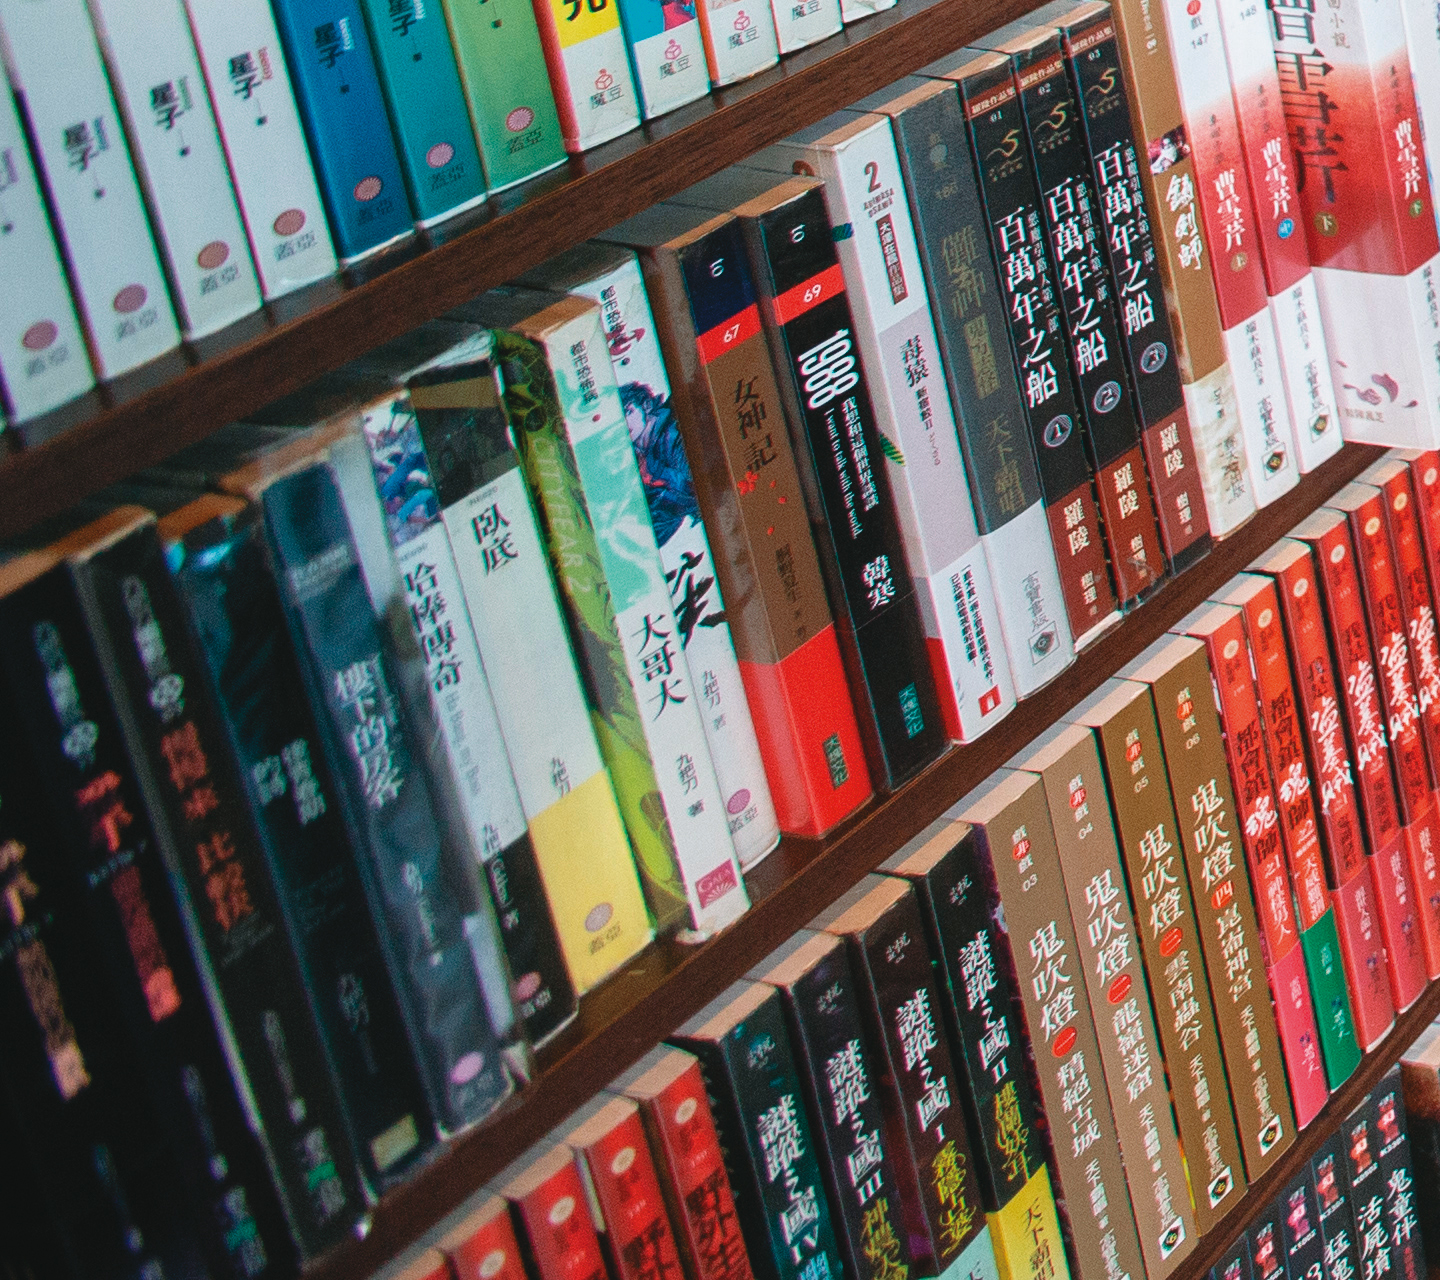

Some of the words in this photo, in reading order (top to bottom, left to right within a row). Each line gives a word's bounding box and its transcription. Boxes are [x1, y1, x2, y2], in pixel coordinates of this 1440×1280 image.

[1190, 32, 1210, 49] 147
[1239, 4, 1259, 21] 148
[864, 160, 883, 195] 2
[1044, 176, 1109, 376] 百萬年之船
[1093, 140, 1156, 337] 百萬年之船
[722, 323, 742, 344] 67
[803, 283, 823, 304] 69
[993, 204, 1061, 409] 百萬年之船
[730, 374, 777, 471] 女神記
[1062, 497, 1092, 557] 羅陵
[1111, 462, 1139, 519] 羅陵
[470, 501, 519, 578] 臥底
[860, 555, 896, 611] 韓寒
[403, 560, 464, 696] 哈棒傳奇
[631, 612, 688, 724] 大哥大
[676, 752, 700, 806] 九把刀
[1138, 825, 1184, 938] 鬼吹燈
[1190, 779, 1237, 888] 鬼吹燈
[1025, 919, 1081, 1029] 鬼吹燈
[1083, 869, 1134, 988] 鬼吹燈
[1055, 1049, 1103, 1160] 精絕古城
